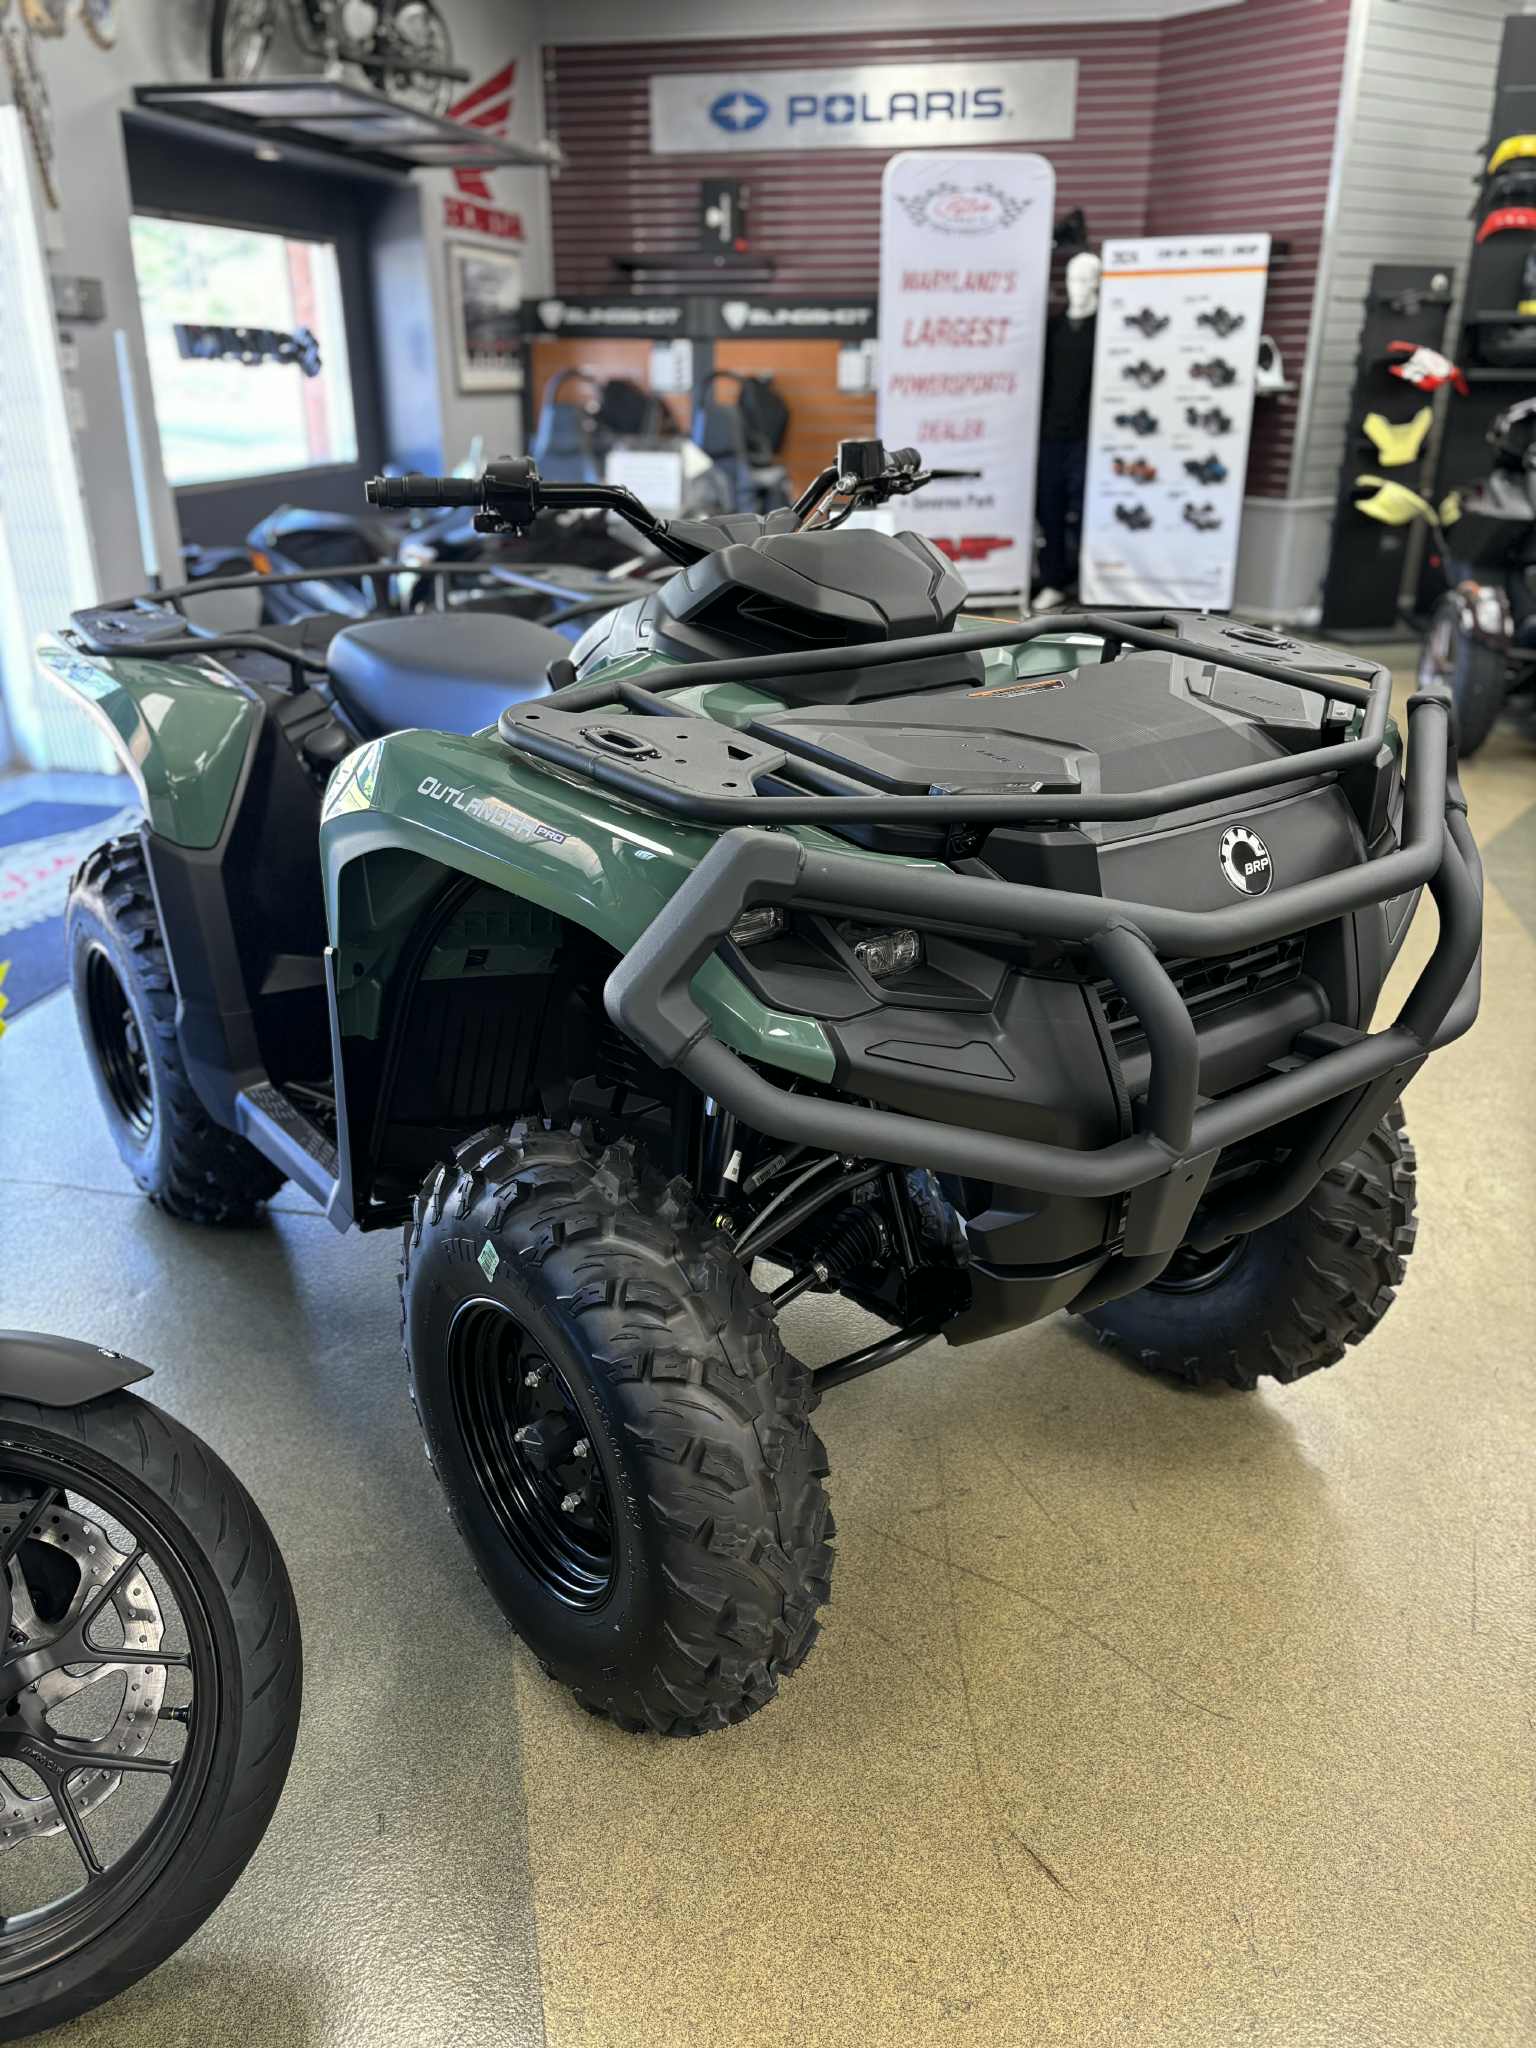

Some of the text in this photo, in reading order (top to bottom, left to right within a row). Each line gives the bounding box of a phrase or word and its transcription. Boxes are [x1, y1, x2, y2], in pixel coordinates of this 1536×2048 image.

[786, 87, 1005, 127] POLARIS
[902, 317, 1010, 347] LARGEST
[918, 419, 985, 442] DEALER
[416, 775, 565, 844] OUTLANDER PRO
[1244, 857, 1269, 876] BRP
